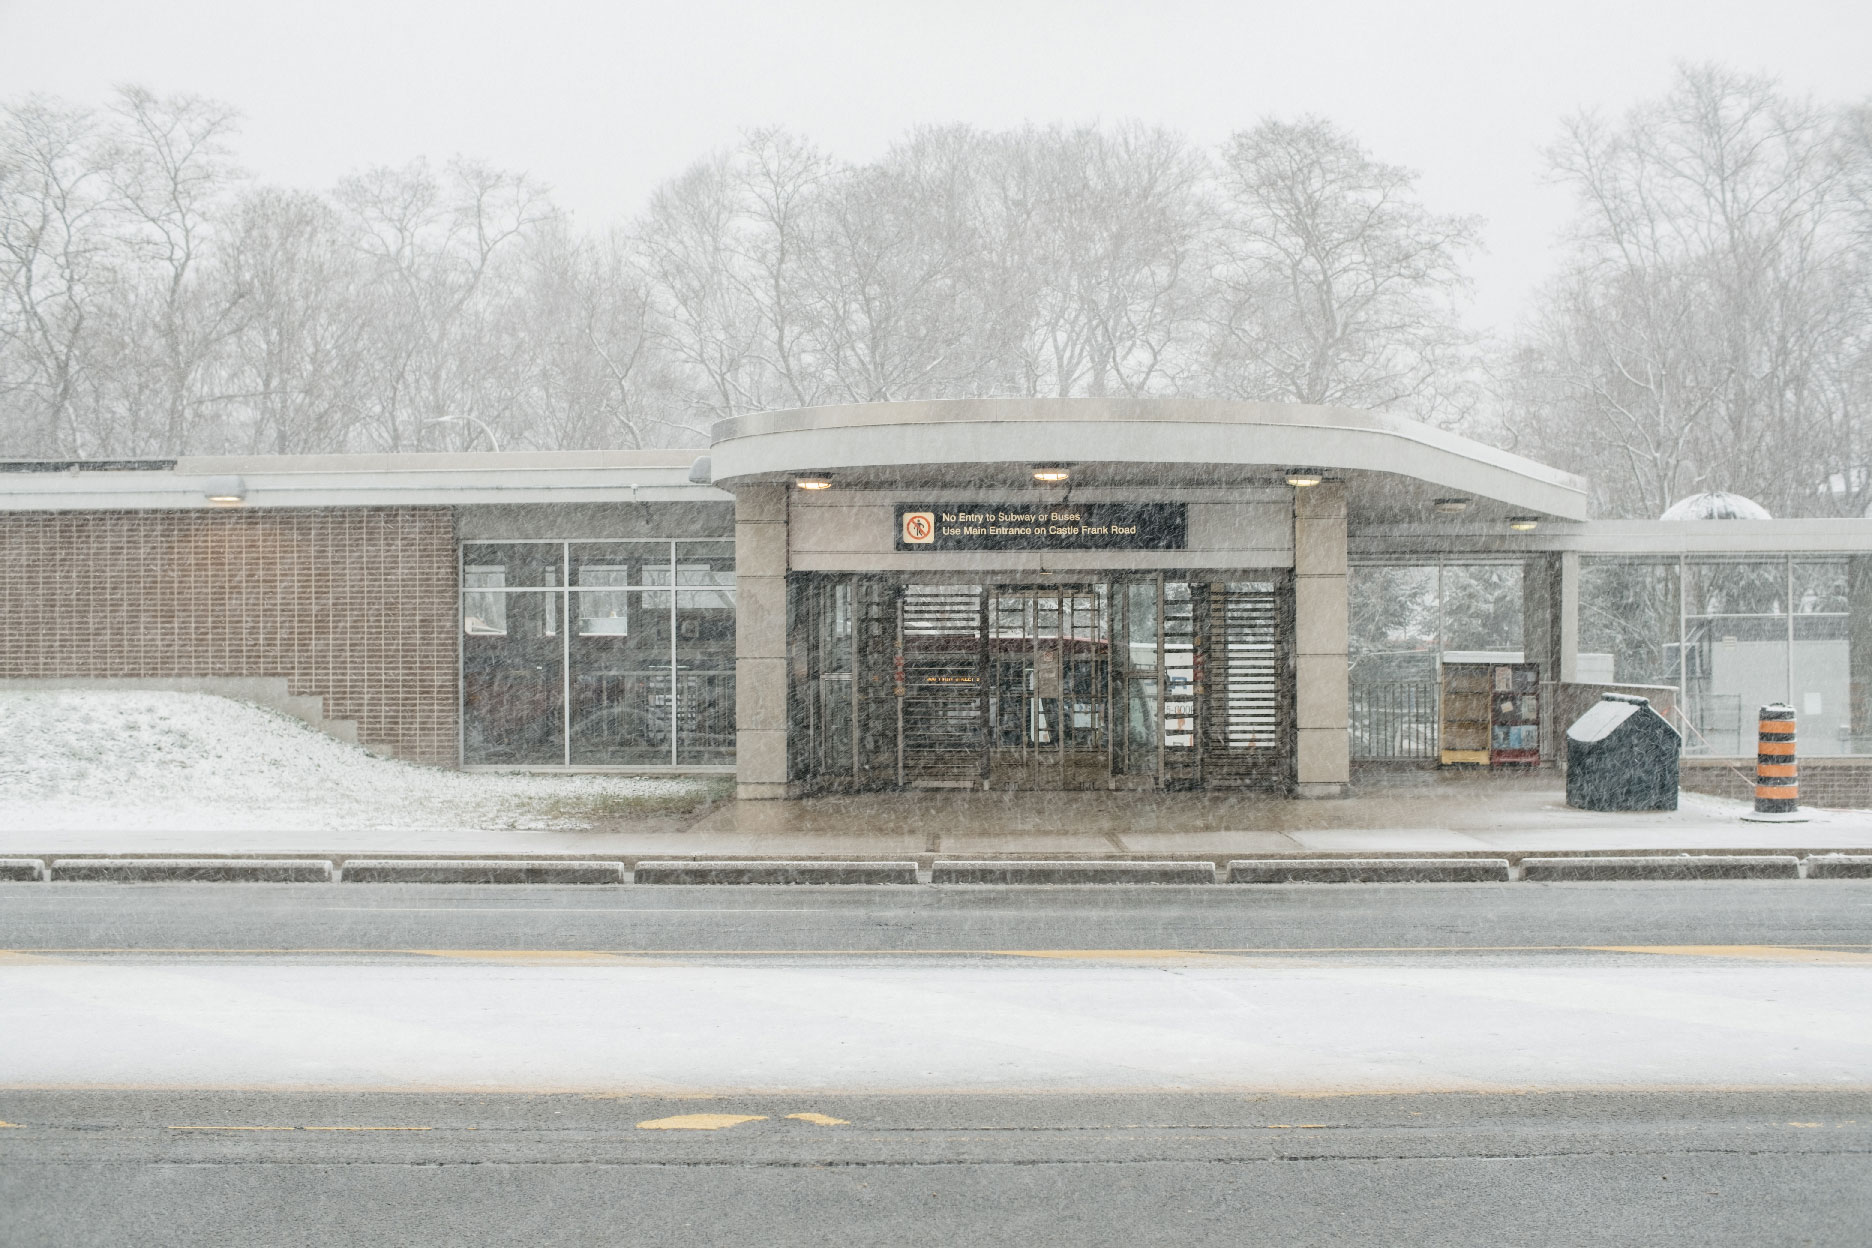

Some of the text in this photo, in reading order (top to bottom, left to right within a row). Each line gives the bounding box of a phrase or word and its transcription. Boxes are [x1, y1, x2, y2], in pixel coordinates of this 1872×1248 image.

[942, 512, 1081, 523] No Entry to Subway or Buses
[943, 527, 960, 535] Use
[1049, 526, 1078, 534] Castle
[1082, 525, 1108, 534] Frank
[1111, 525, 1136, 534] Road
